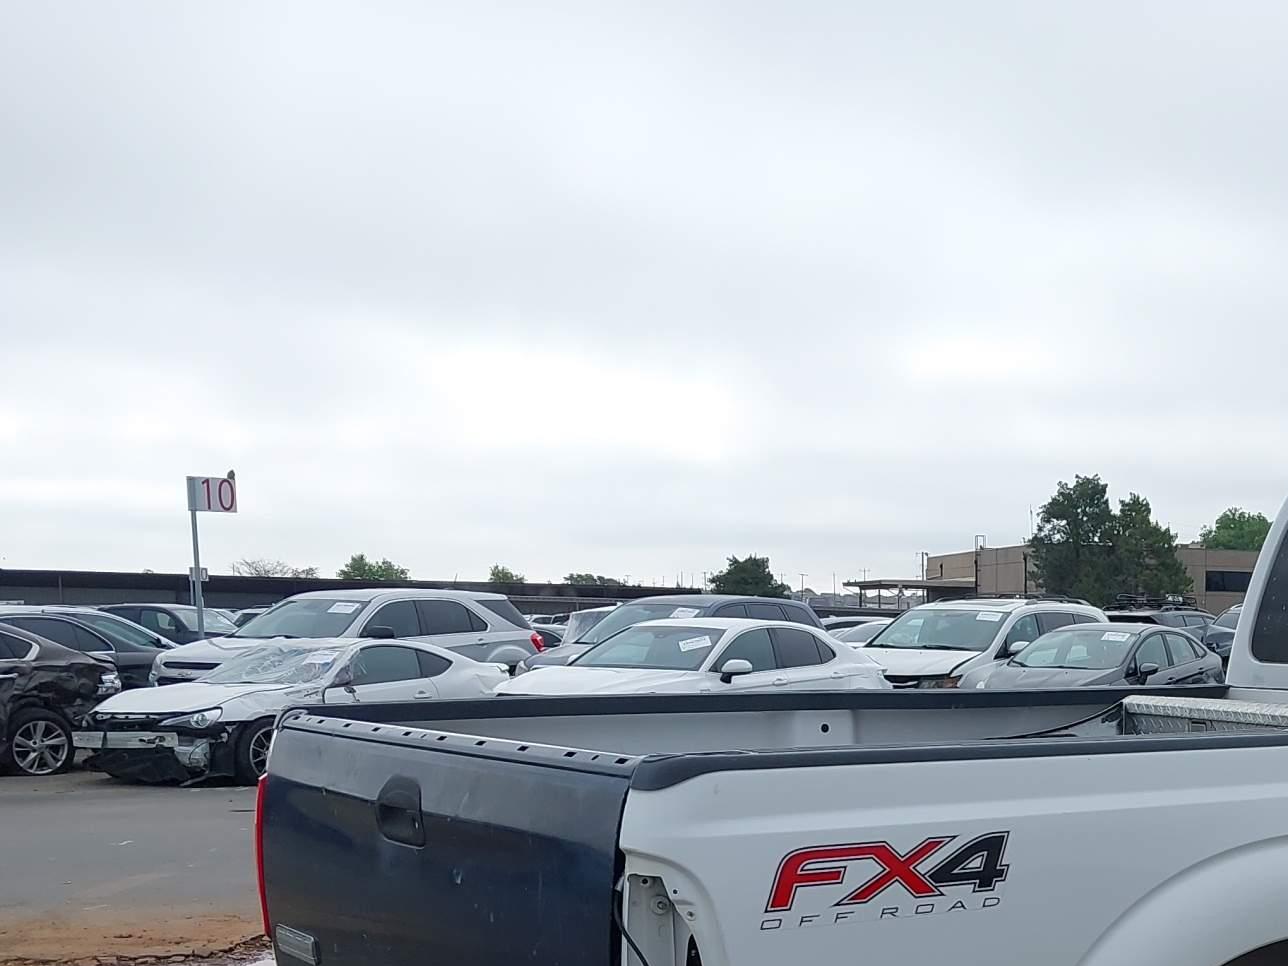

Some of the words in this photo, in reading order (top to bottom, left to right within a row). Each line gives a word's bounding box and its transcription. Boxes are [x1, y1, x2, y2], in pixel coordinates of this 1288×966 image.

[201, 478, 235, 511] 10
[764, 831, 1010, 913] FX4
[760, 911, 856, 930] OFF
[880, 897, 1001, 920] ROAD
